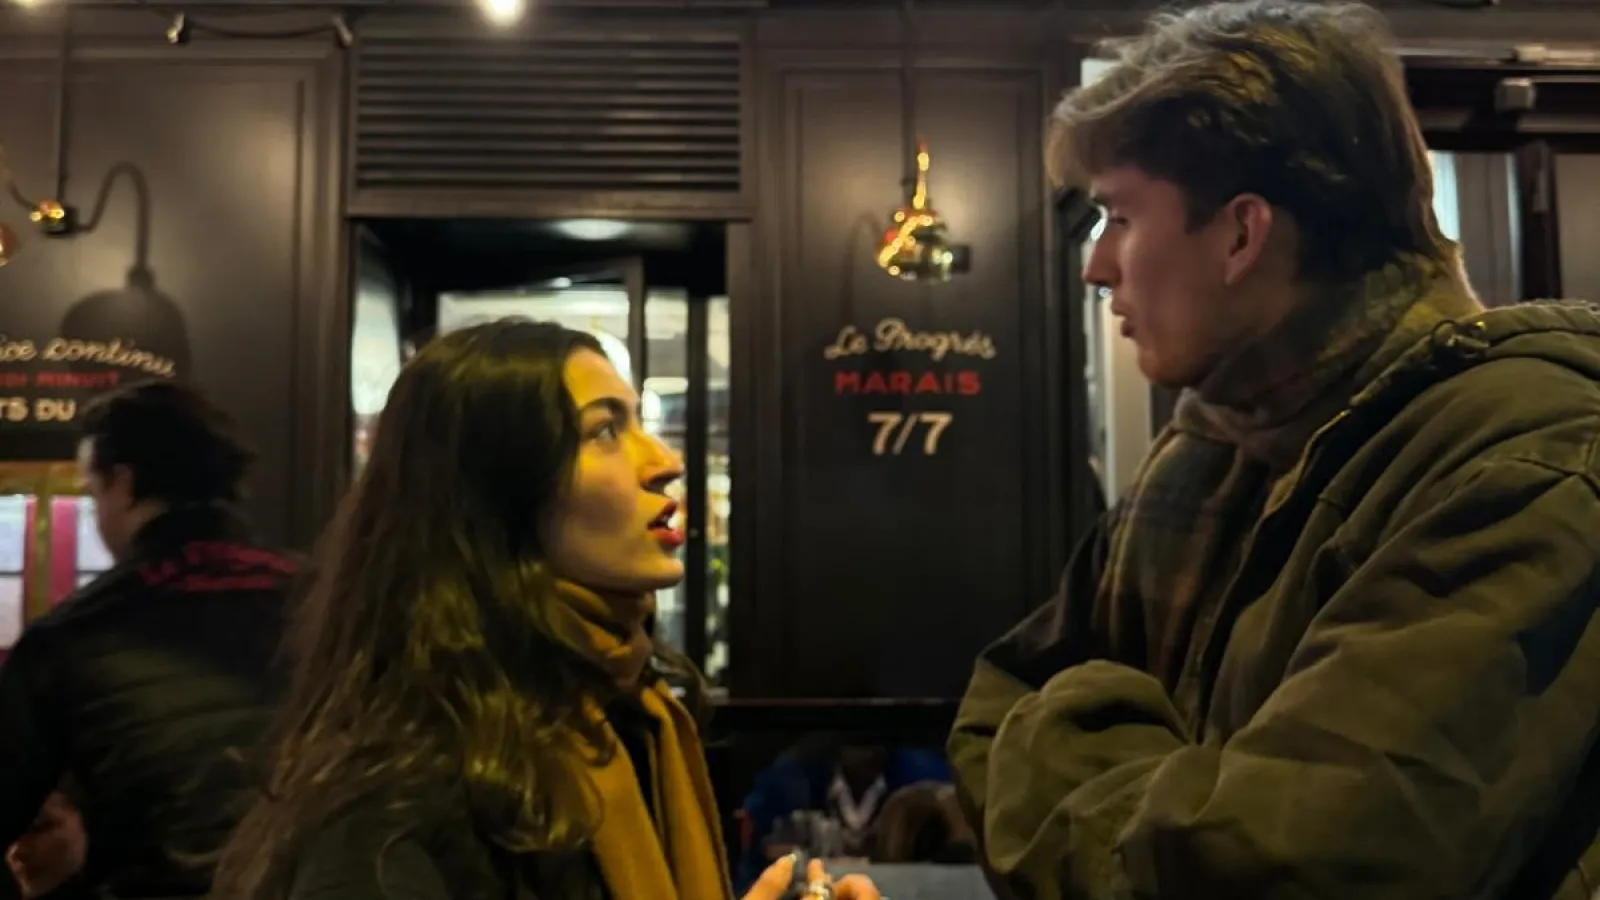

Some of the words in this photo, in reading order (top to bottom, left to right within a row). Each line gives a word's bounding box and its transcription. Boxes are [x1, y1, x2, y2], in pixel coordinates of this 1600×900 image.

[43, 338, 175, 378] continu
[824, 325, 867, 360] Le
[835, 371, 981, 395] MARAIS
[36, 398, 76, 421] DU
[868, 412, 952, 454] 7/7
